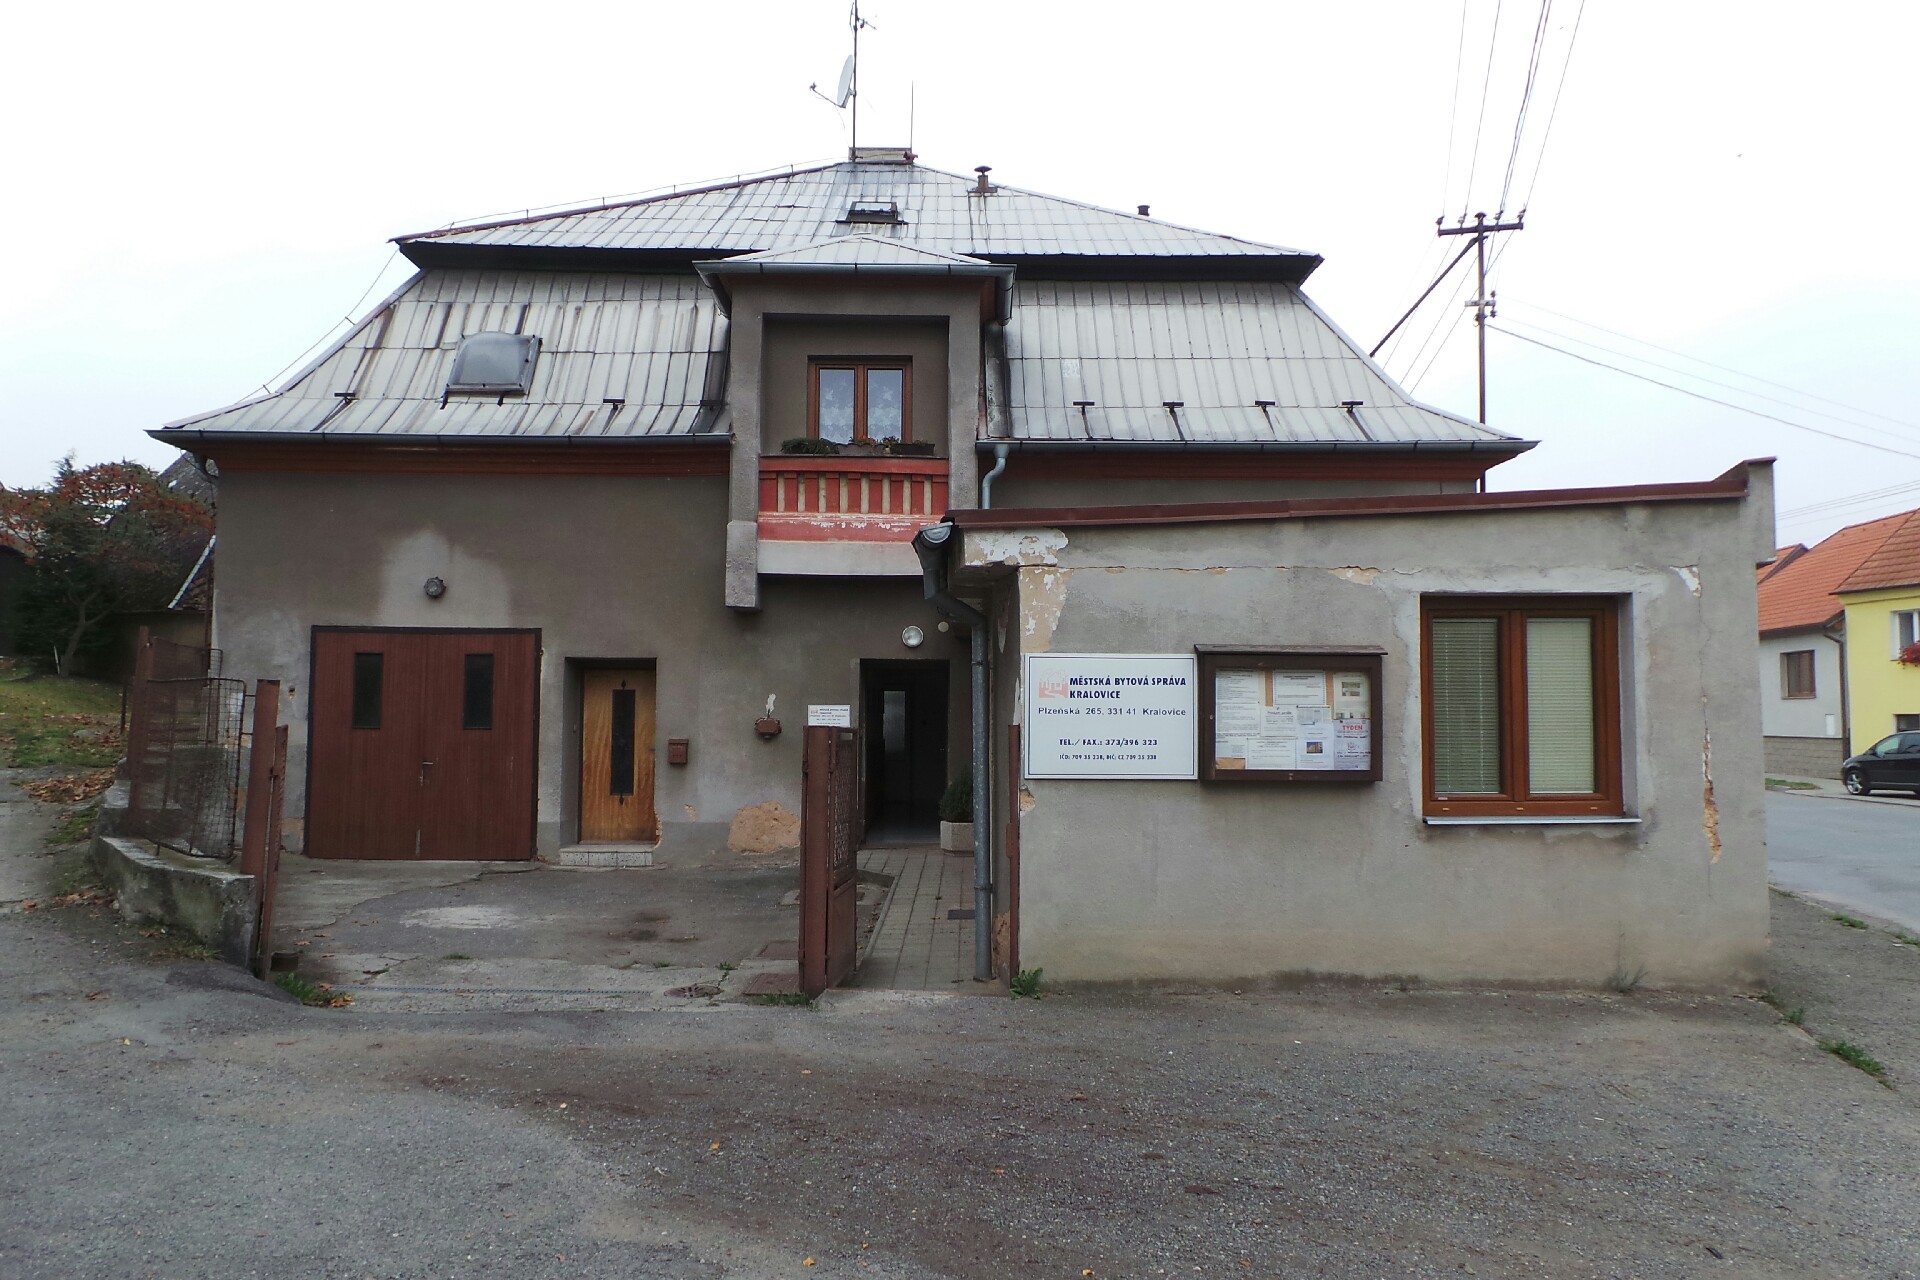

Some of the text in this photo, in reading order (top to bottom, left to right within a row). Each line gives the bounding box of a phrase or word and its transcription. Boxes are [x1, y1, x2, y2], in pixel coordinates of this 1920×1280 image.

[1069, 675, 1187, 686] MĚSTSKÁ BYTOVÁ SPRÁVA
[1069, 690, 1121, 699] KRALOVICE
[1038, 707, 1080, 715] Plzeňská
[1142, 708, 1187, 716] Kralovice
[1105, 738, 1139, 747] 373/396
